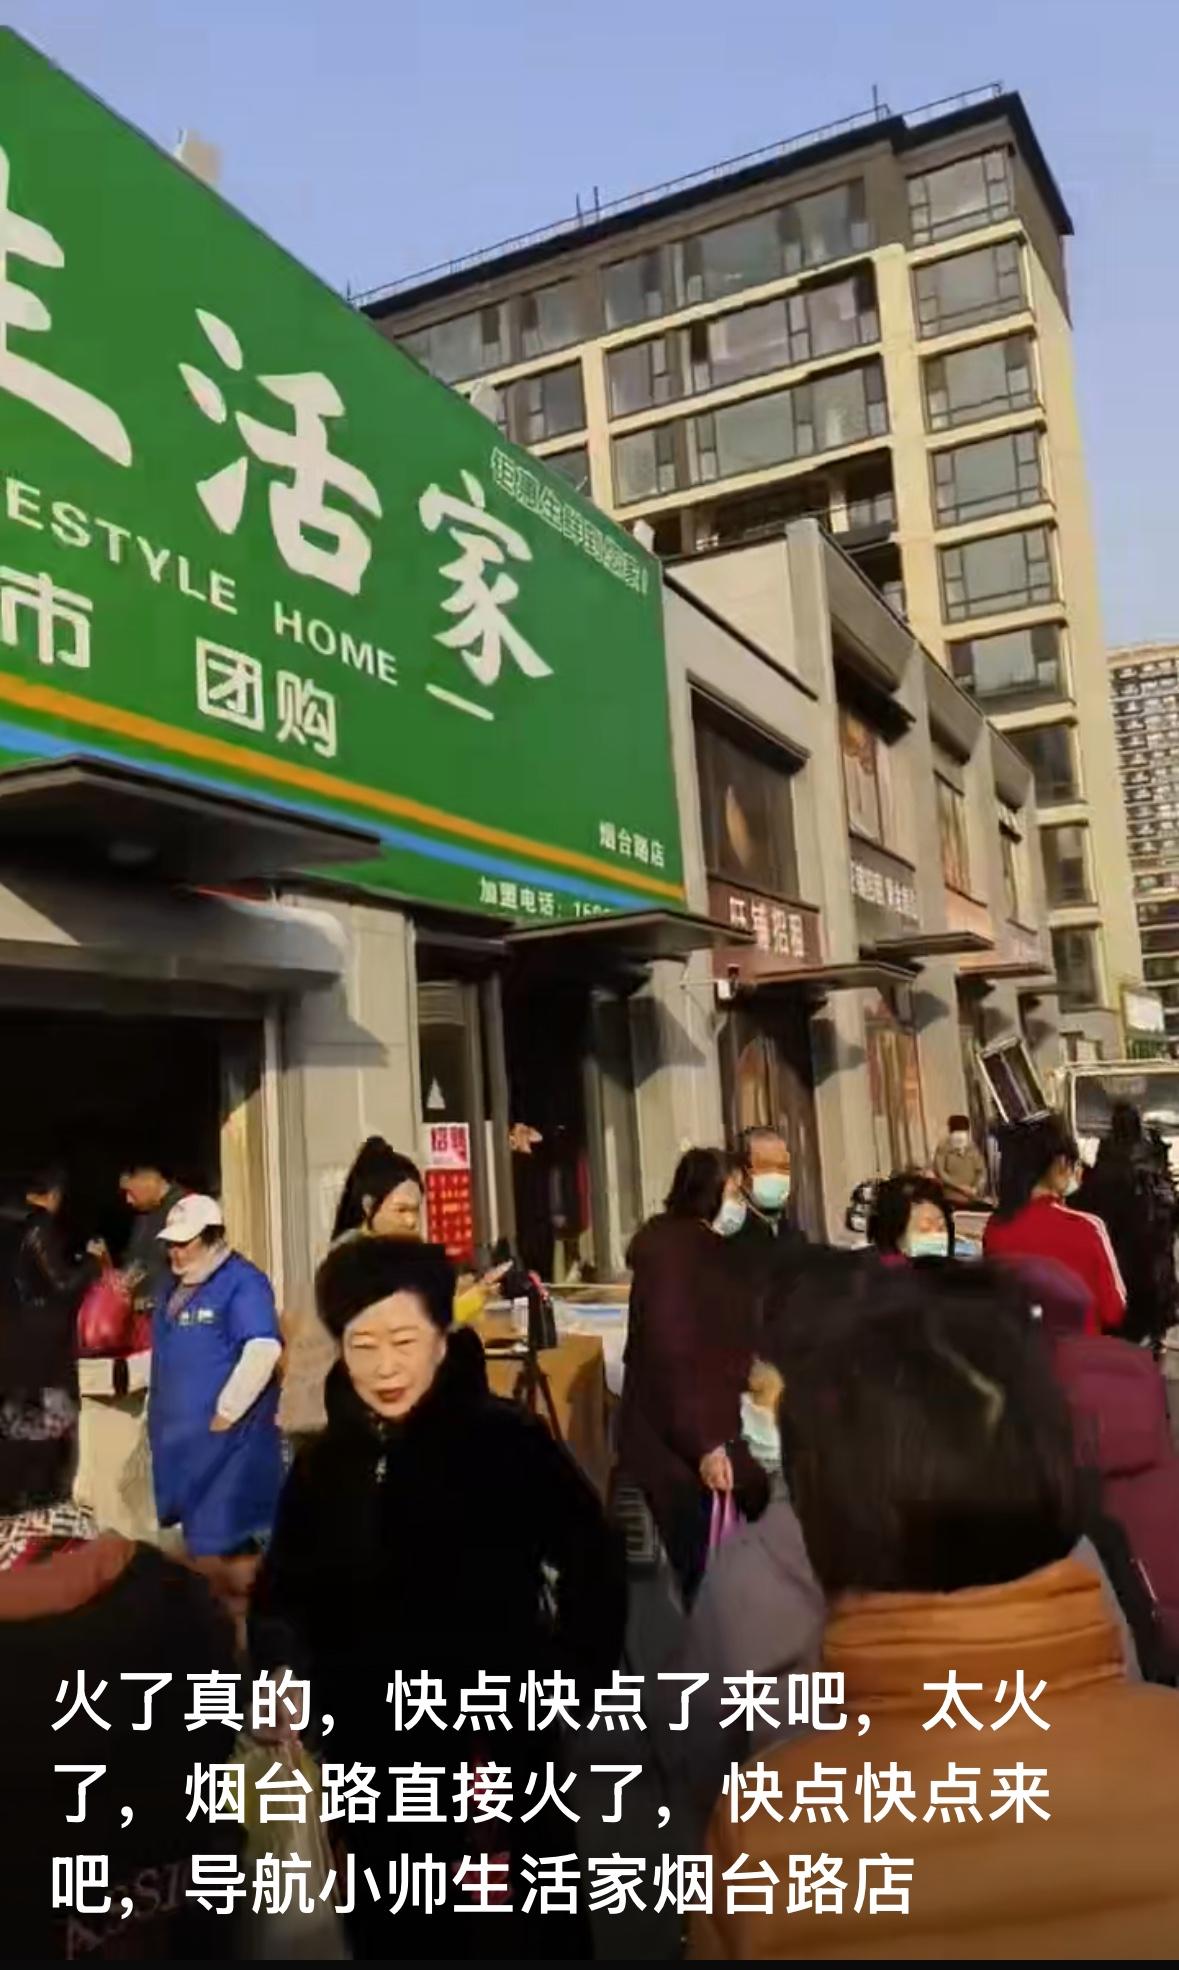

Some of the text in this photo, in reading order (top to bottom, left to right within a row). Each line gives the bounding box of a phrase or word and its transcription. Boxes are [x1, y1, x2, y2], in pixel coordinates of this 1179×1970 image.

[274, 600, 399, 686] HOME
[196, 636, 337, 758] 团购
[599, 820, 665, 868] 烟台路店
